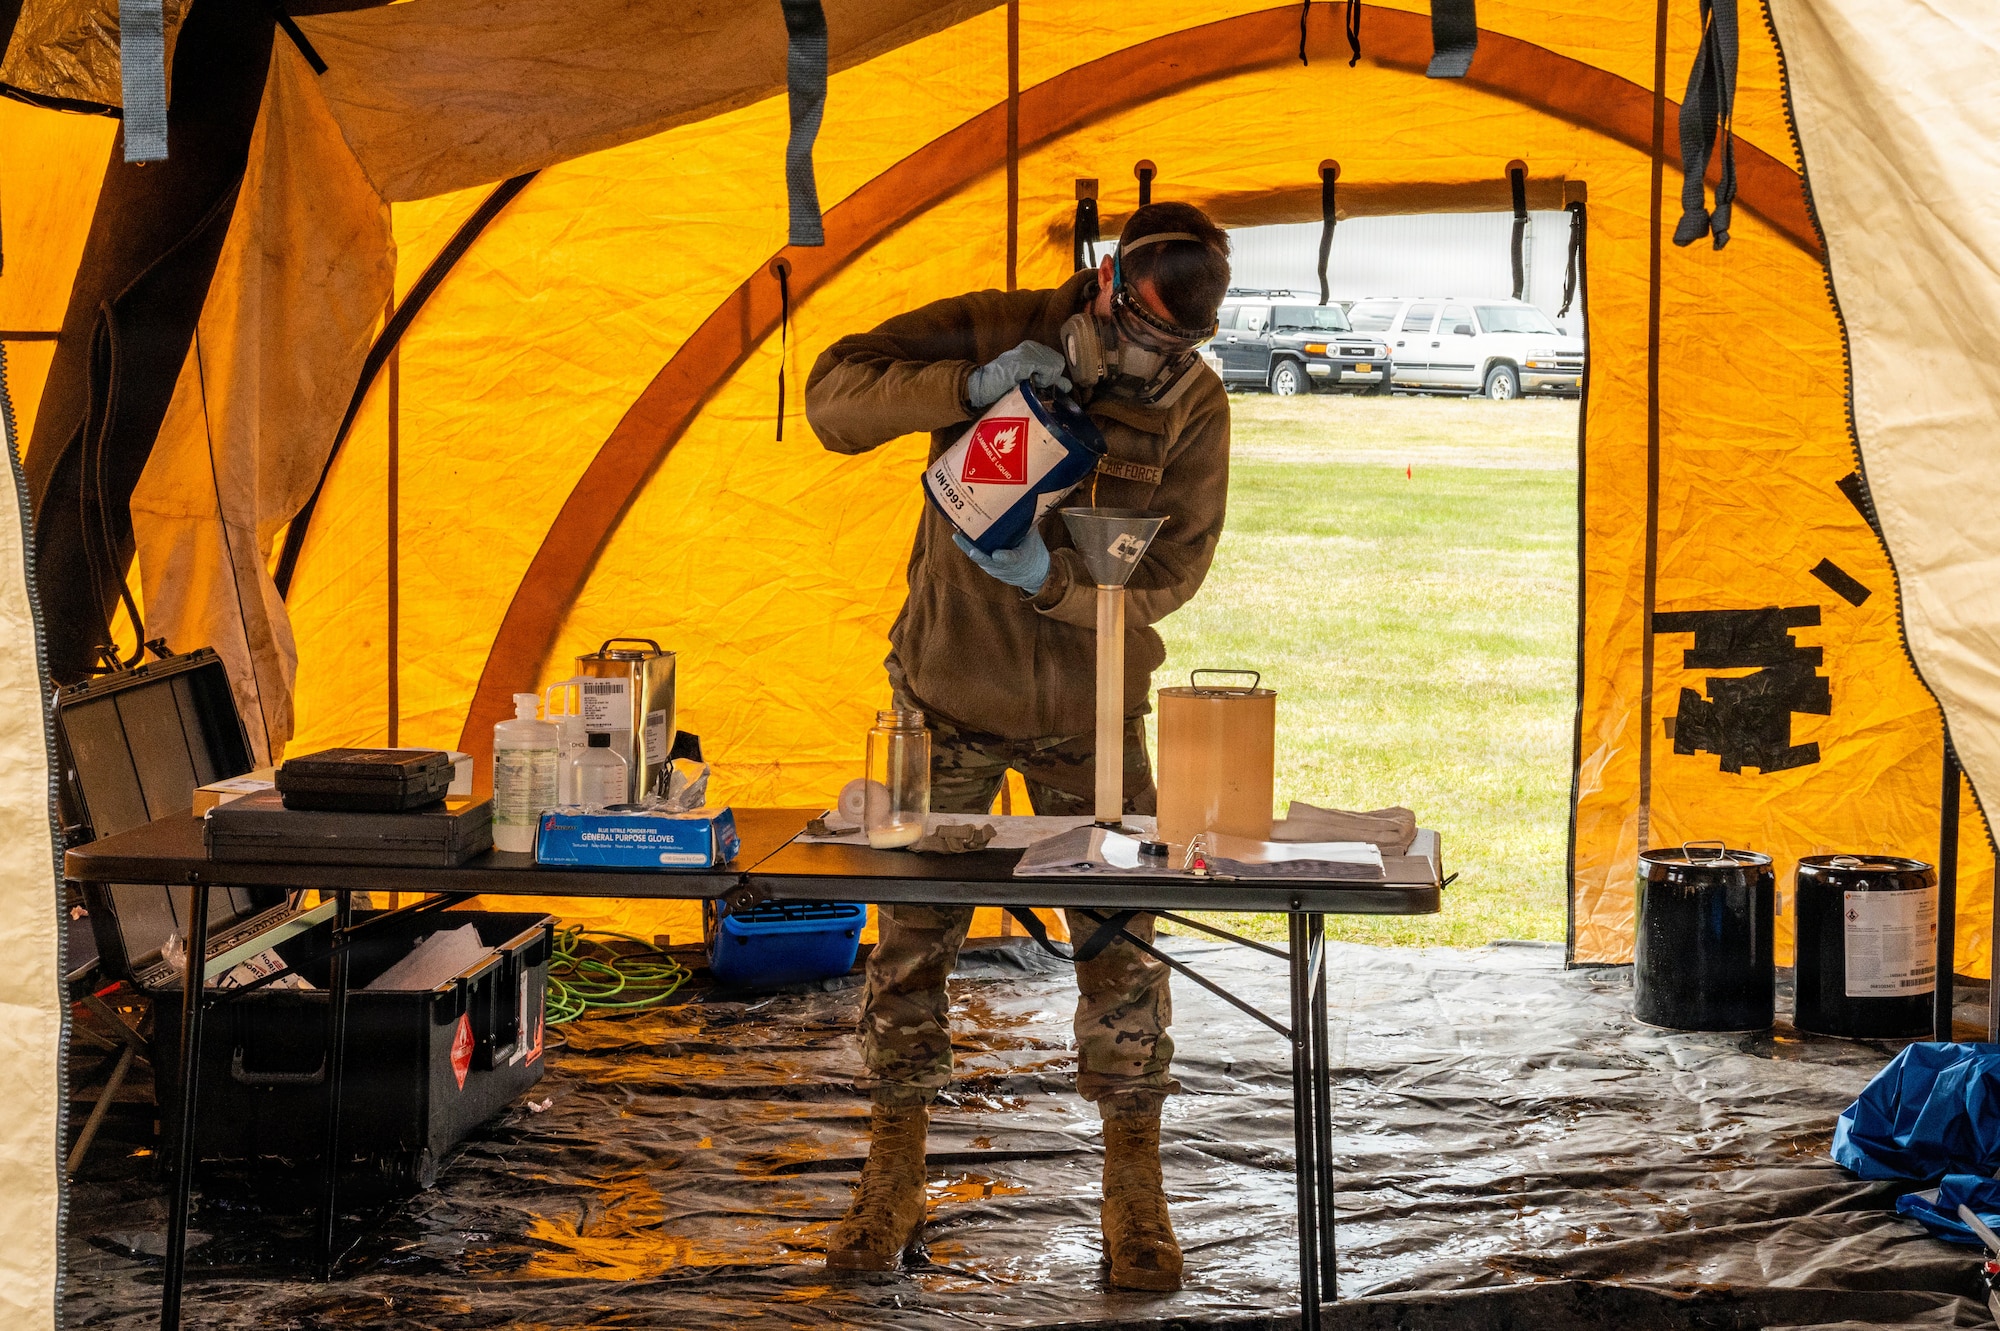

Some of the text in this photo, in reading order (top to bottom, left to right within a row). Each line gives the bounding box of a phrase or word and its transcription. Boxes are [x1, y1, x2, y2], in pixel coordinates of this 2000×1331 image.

[976, 432, 1012, 480] FLAMMABLE LIQUID
[968, 467, 976, 476] 3
[1105, 463, 1123, 475] AIR
[1124, 465, 1159, 481] FORCE
[935, 469, 965, 510] UN1993
[581, 833, 675, 843] GENERAL PURPOSE GLOVES
